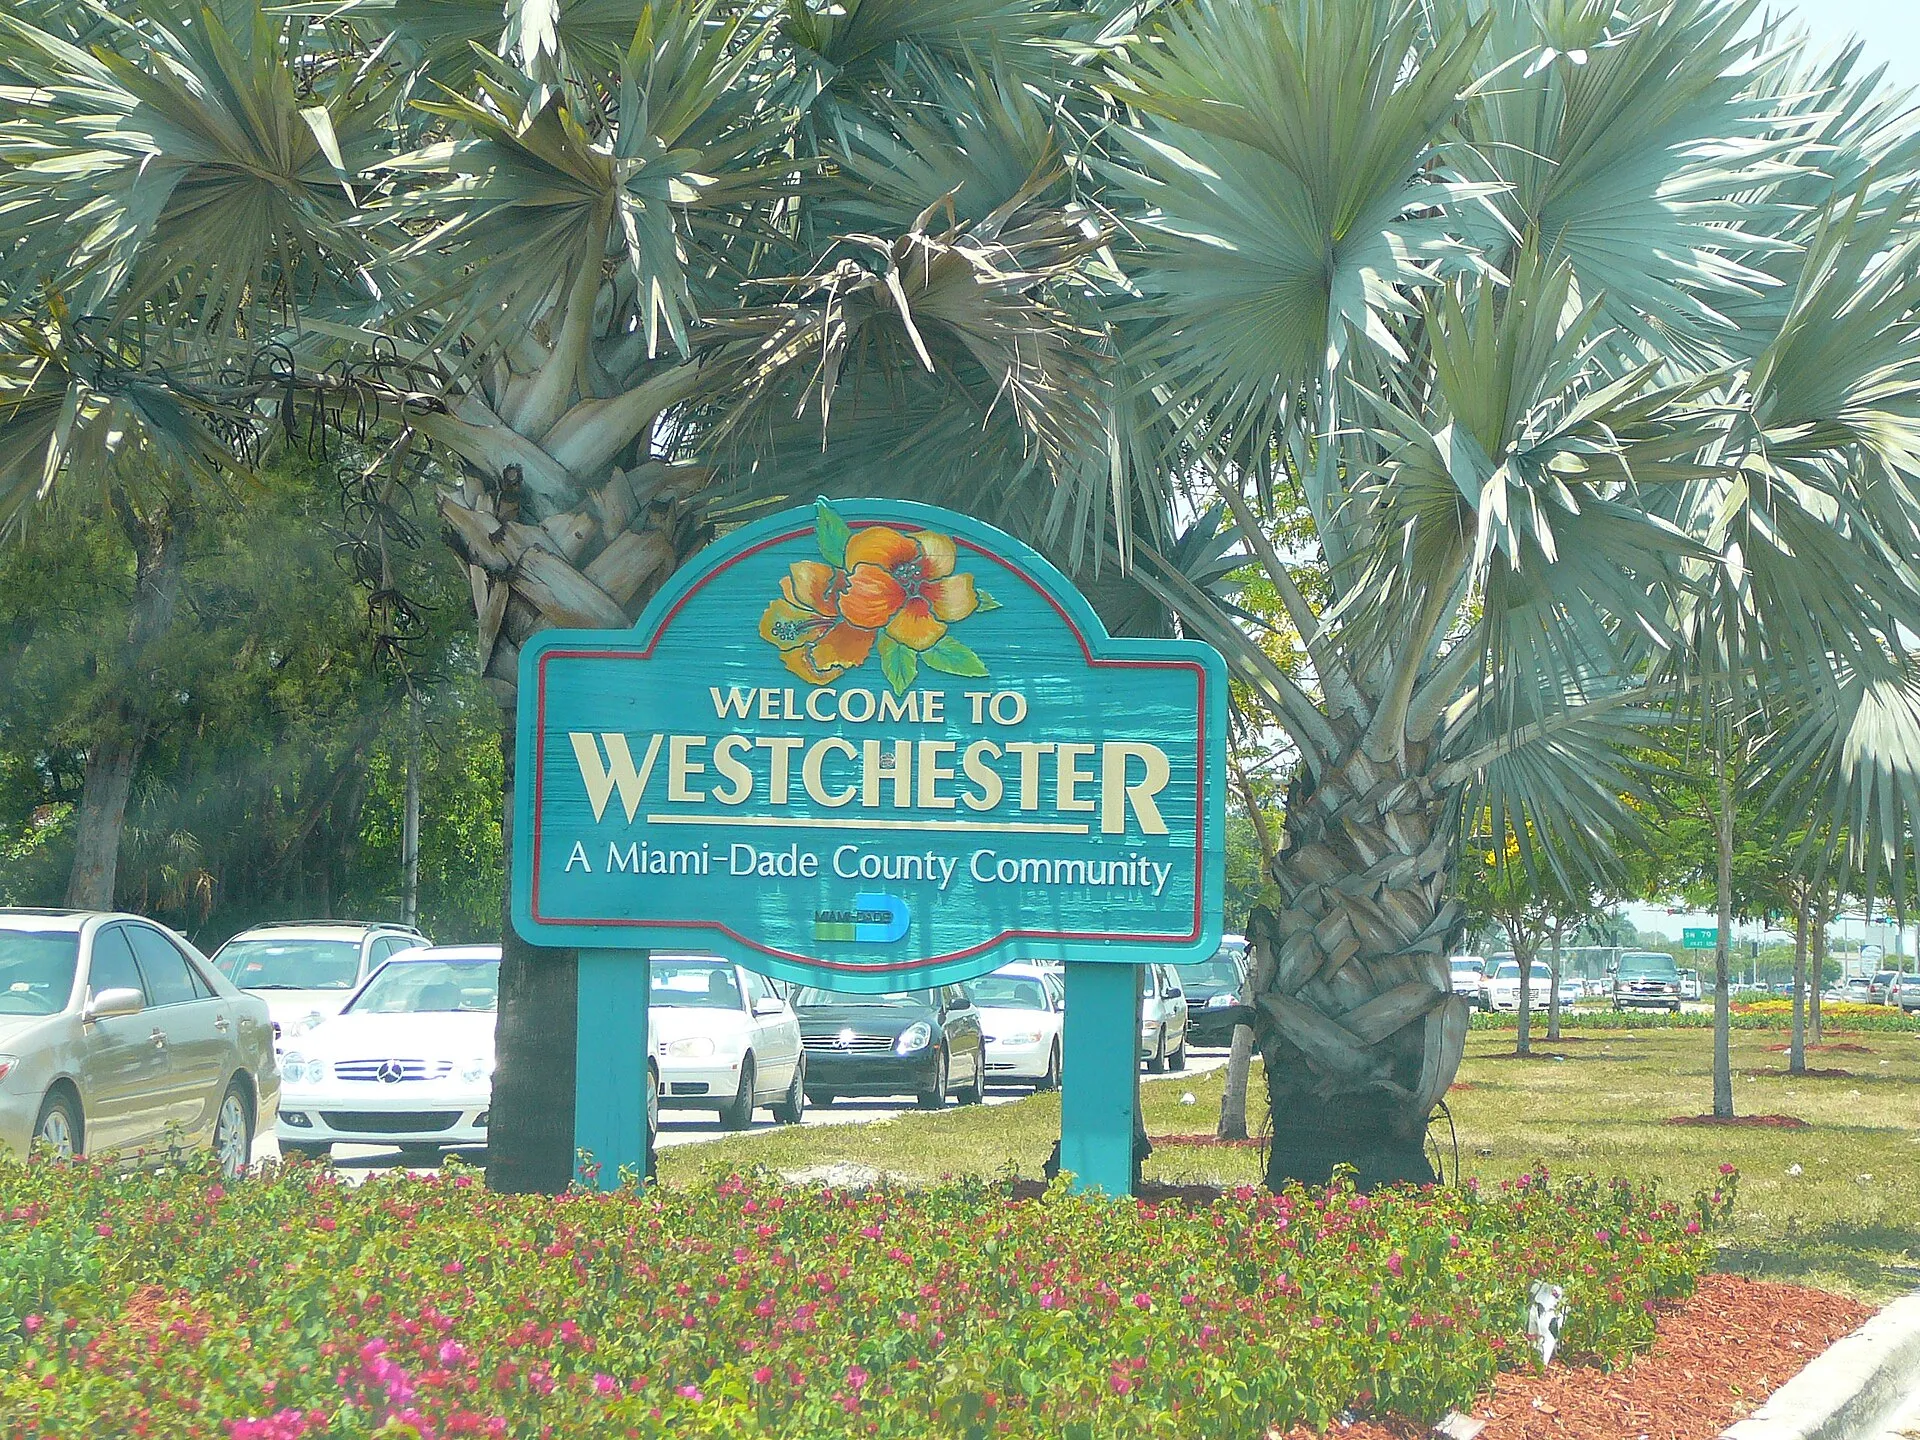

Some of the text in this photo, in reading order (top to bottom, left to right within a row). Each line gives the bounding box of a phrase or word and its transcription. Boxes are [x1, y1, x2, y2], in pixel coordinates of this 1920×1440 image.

[708, 686, 1028, 726] WELCOME TO
[567, 731, 1171, 835] WESTCHESTER
[564, 840, 1173, 897] A Miami-Dade County Community
